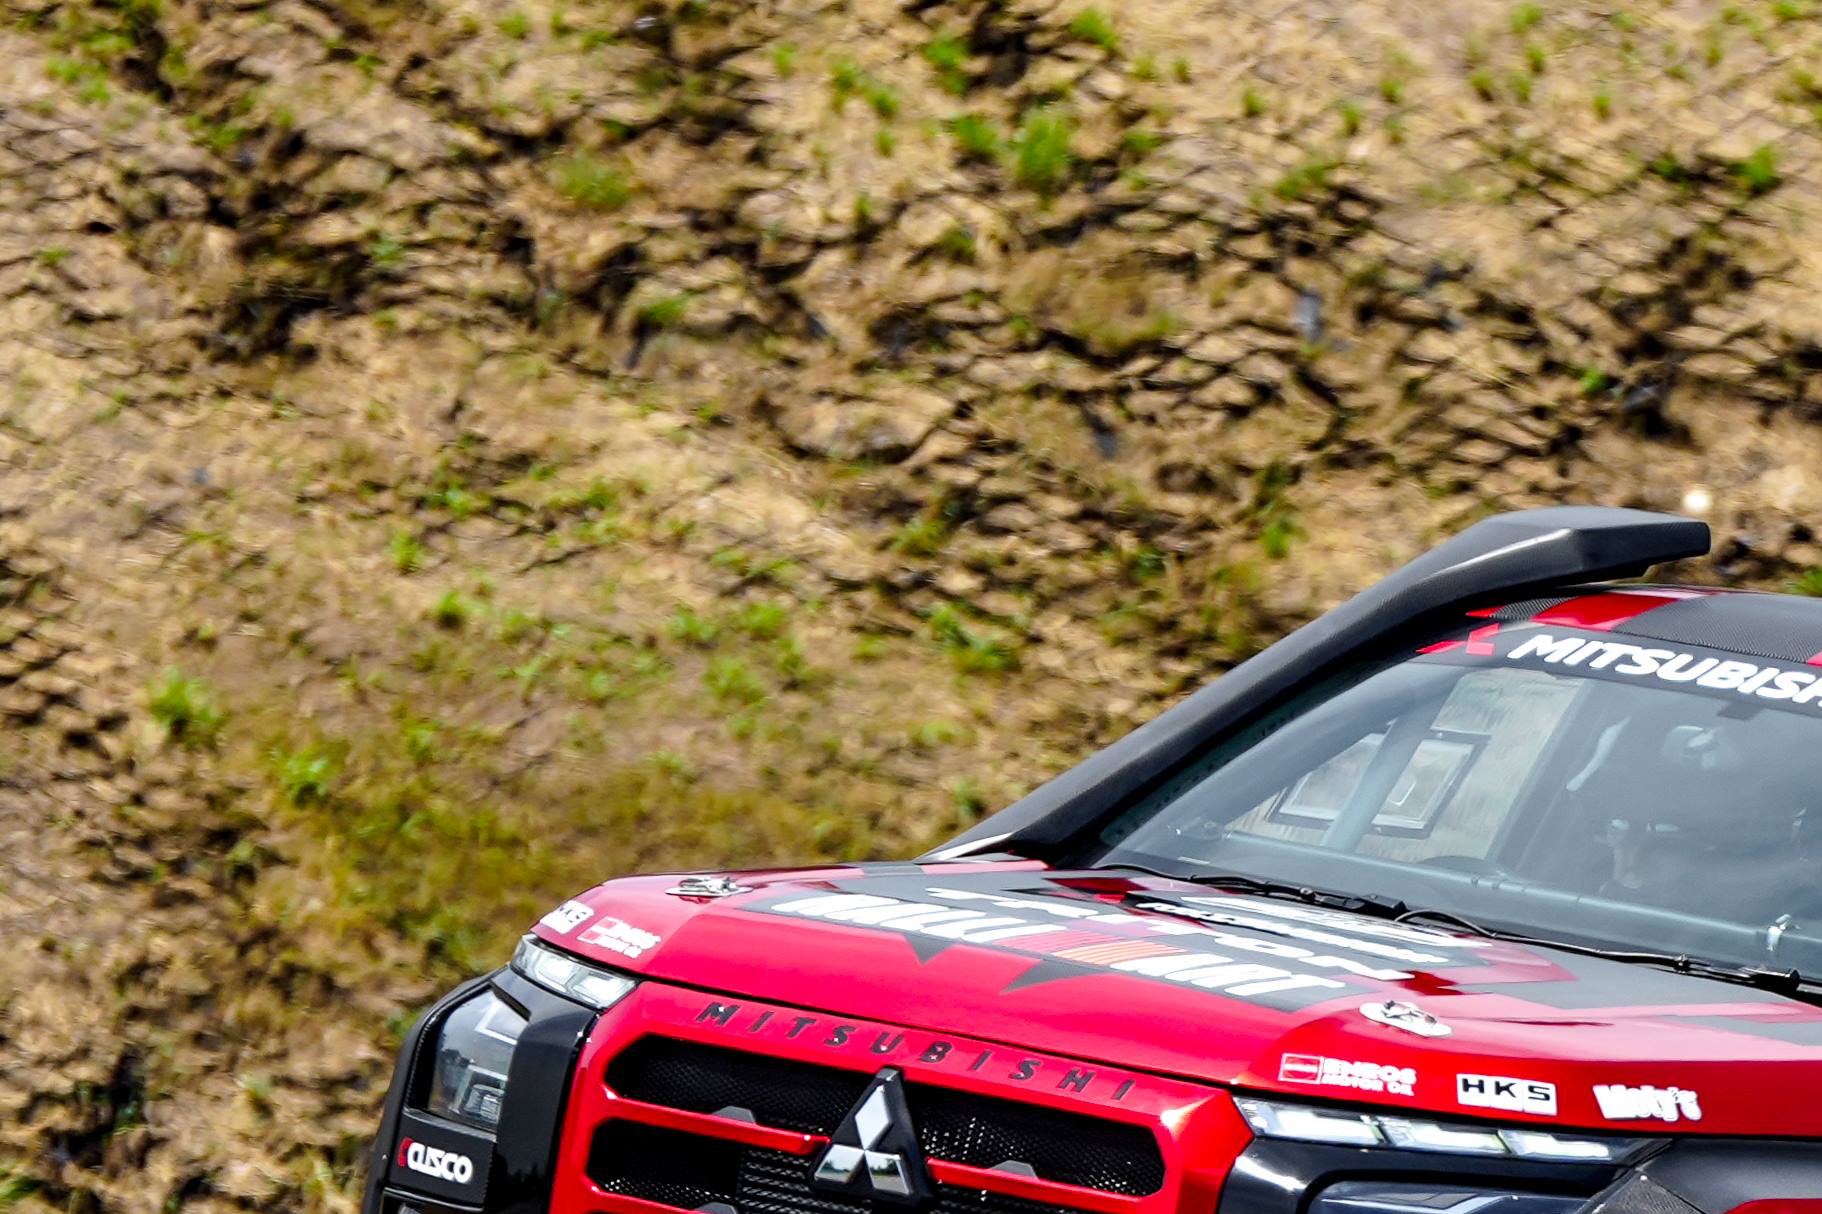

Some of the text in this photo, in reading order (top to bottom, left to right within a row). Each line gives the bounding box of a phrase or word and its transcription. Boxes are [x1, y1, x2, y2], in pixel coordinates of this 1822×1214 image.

[699, 1001, 1137, 1101] MITSUBISHI
[1460, 1076, 1552, 1102] HKS
[407, 1141, 474, 1185] CUSCO
